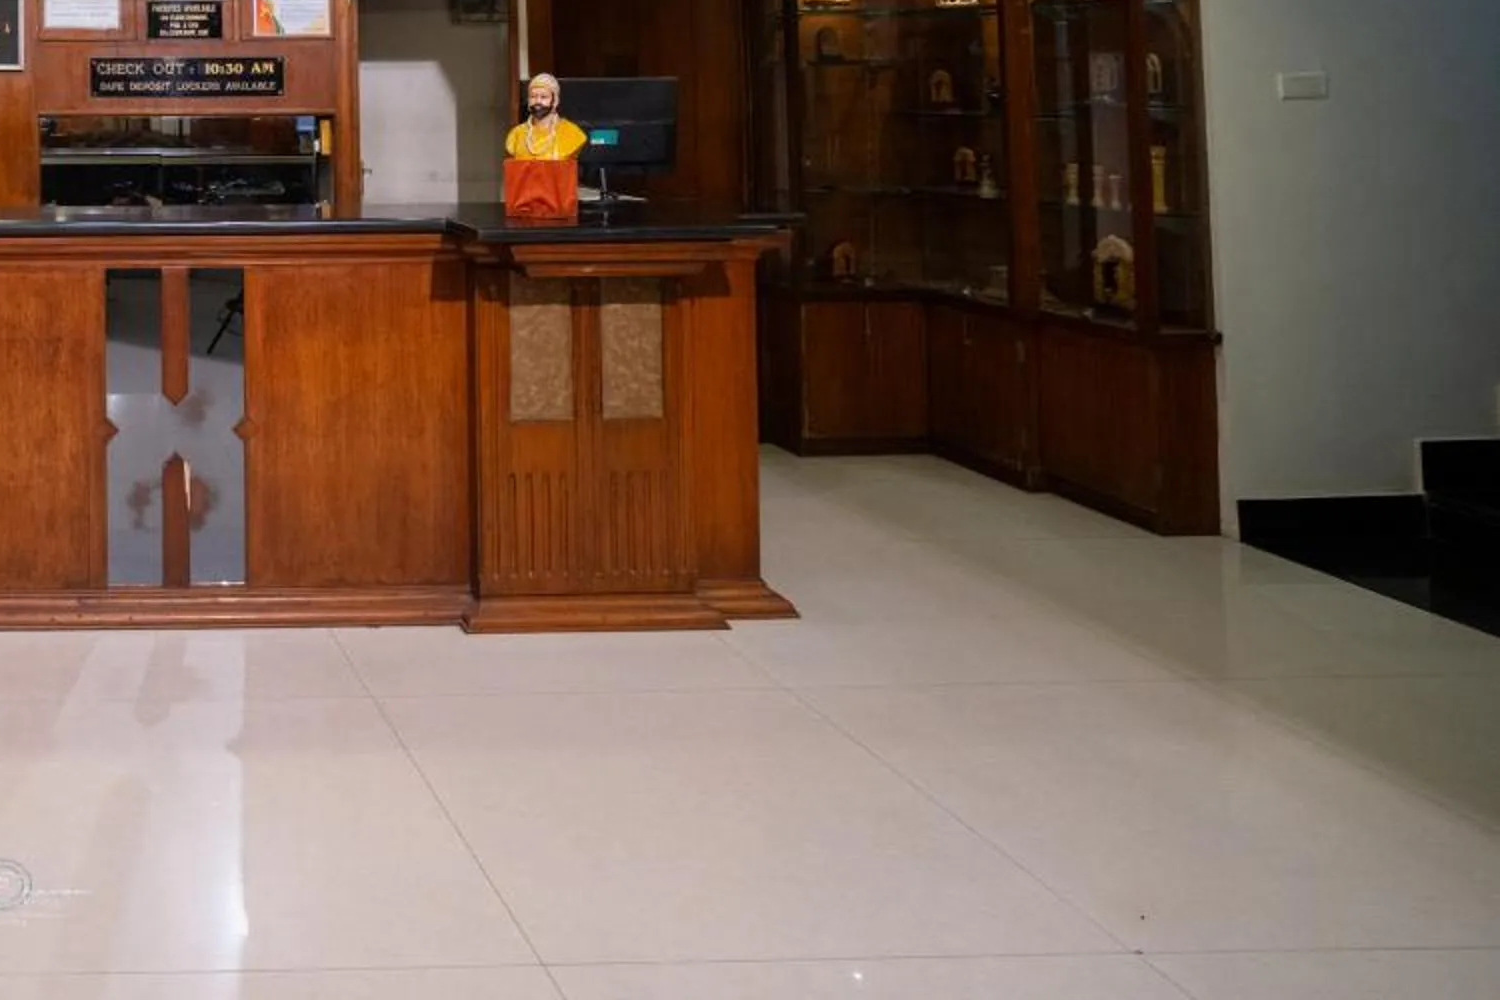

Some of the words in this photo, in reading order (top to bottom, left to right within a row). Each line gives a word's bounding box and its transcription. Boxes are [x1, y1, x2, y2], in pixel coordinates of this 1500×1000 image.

[97, 62, 145, 75] CHECK
[204, 62, 244, 75] 10:30
[251, 62, 275, 74] AM
